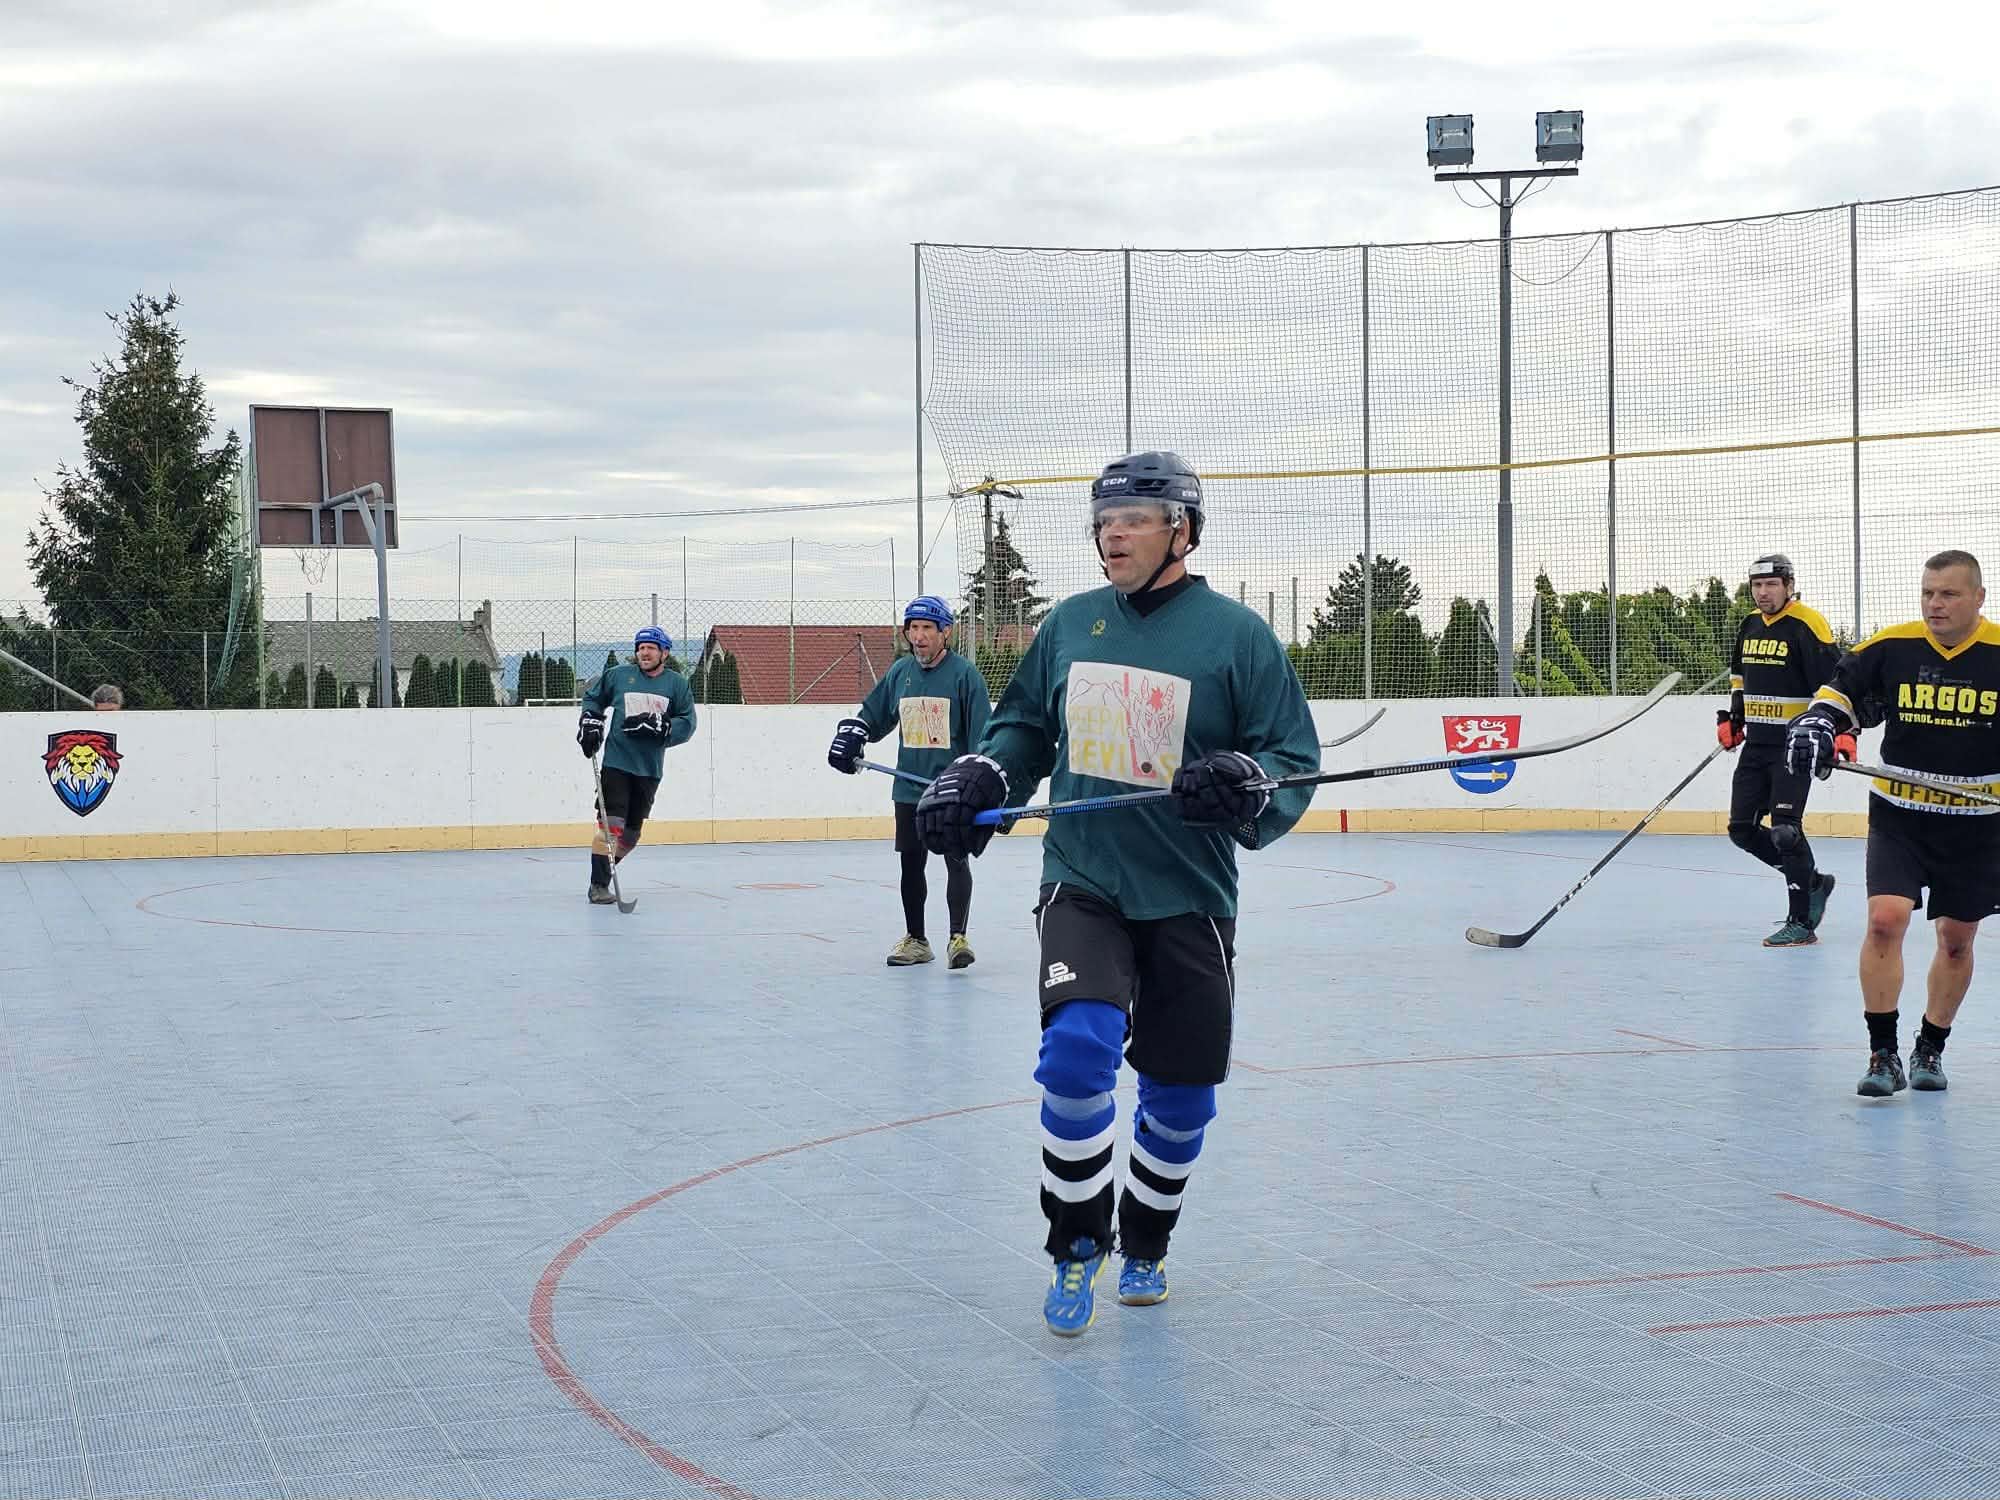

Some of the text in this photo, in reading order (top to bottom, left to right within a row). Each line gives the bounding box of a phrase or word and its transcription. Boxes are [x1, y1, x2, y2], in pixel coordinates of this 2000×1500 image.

[1102, 477, 1128, 487] CCM
[1742, 639, 1789, 657] ARGOS
[1898, 683, 1998, 715] ARGOS
